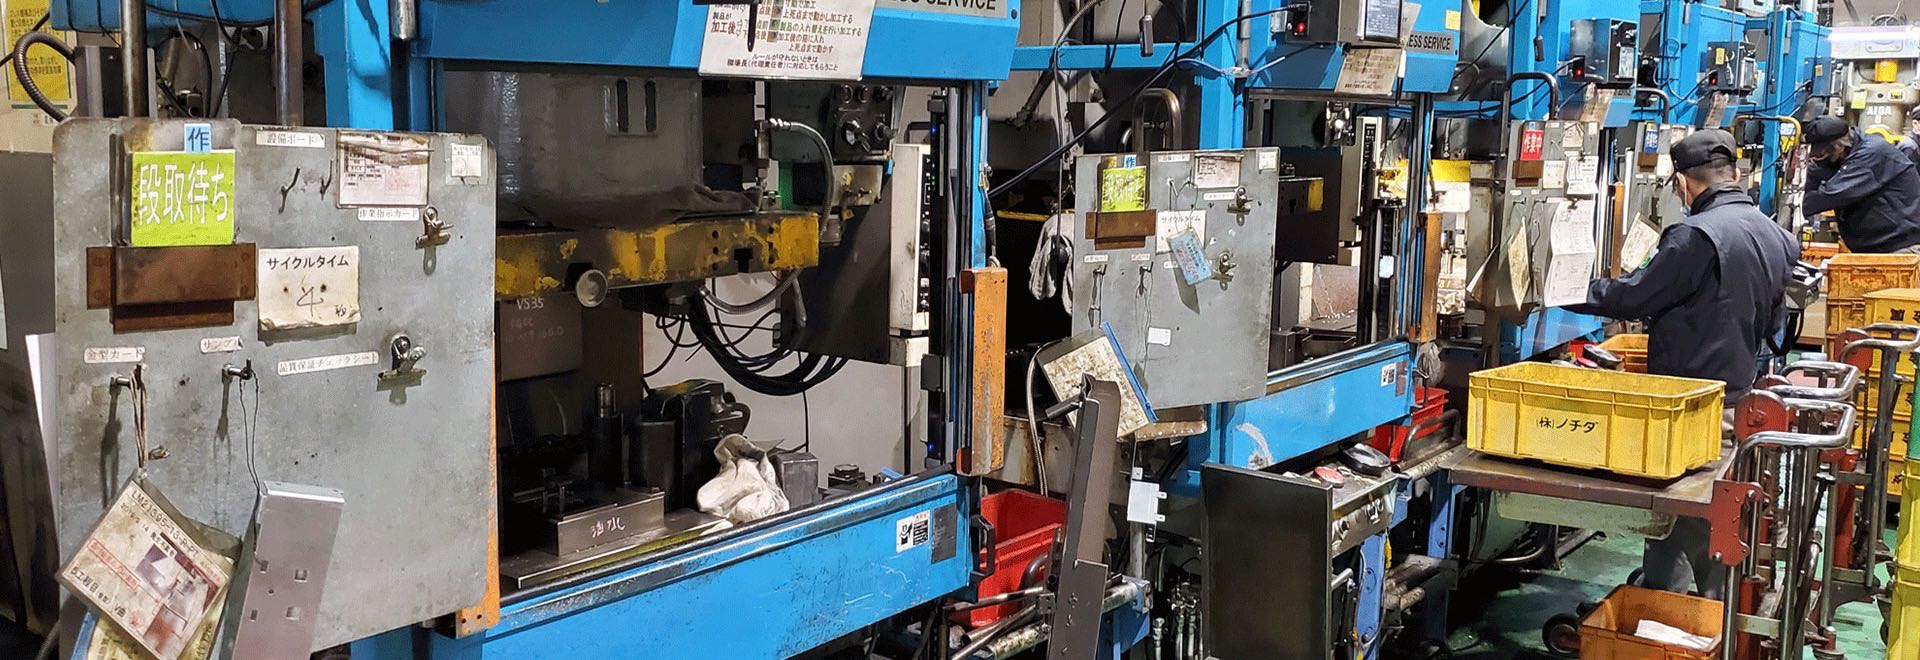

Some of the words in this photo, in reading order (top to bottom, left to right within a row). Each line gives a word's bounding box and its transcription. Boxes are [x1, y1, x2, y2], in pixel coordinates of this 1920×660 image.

[711, 21, 736, 35] 加工後
[1407, 34, 1422, 48] ESS
[1423, 35, 1451, 50] SERVICE
[752, 53, 819, 63] ルールが守れないときは
[188, 127, 210, 152] 作
[138, 161, 228, 226] 段取待ち
[267, 255, 349, 270] サイクルタイム
[516, 297, 544, 310] VS35
